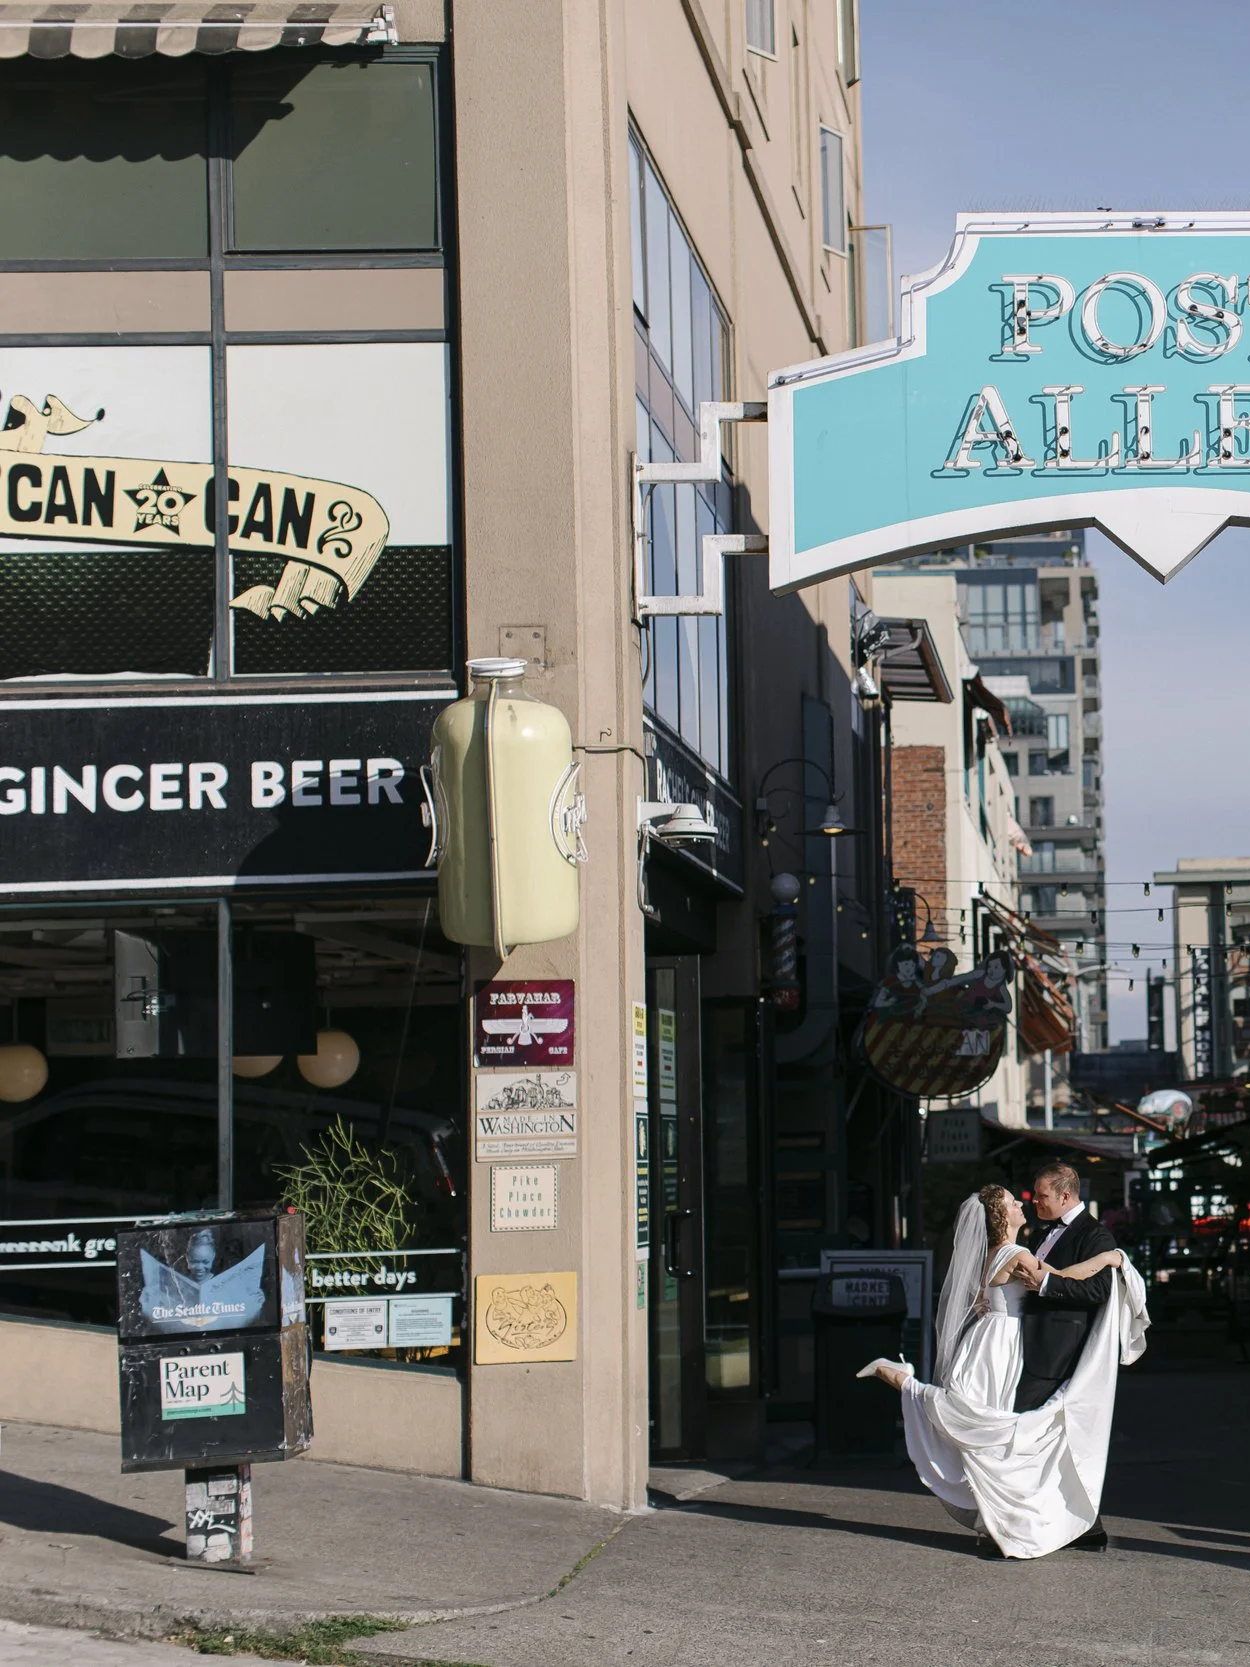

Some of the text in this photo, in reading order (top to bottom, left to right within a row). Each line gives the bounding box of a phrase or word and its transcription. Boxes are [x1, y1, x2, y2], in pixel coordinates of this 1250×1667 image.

[7, 463, 316, 550] CAN CAN
[135, 488, 185, 516] 20
[136, 513, 180, 526] YEARS
[250, 757, 405, 809] BEER
[548, 1046, 568, 1054] CAFE
[479, 1113, 575, 1136] WASHINGTON
[512, 1175, 538, 1186] Pike
[508, 1191, 542, 1202] Place
[499, 1206, 551, 1219] Chowder
[312, 1264, 417, 1291] better days
[152, 1301, 246, 1320] The Seattle Times
[165, 1360, 231, 1380] Parent
[166, 1380, 210, 1402] Map
